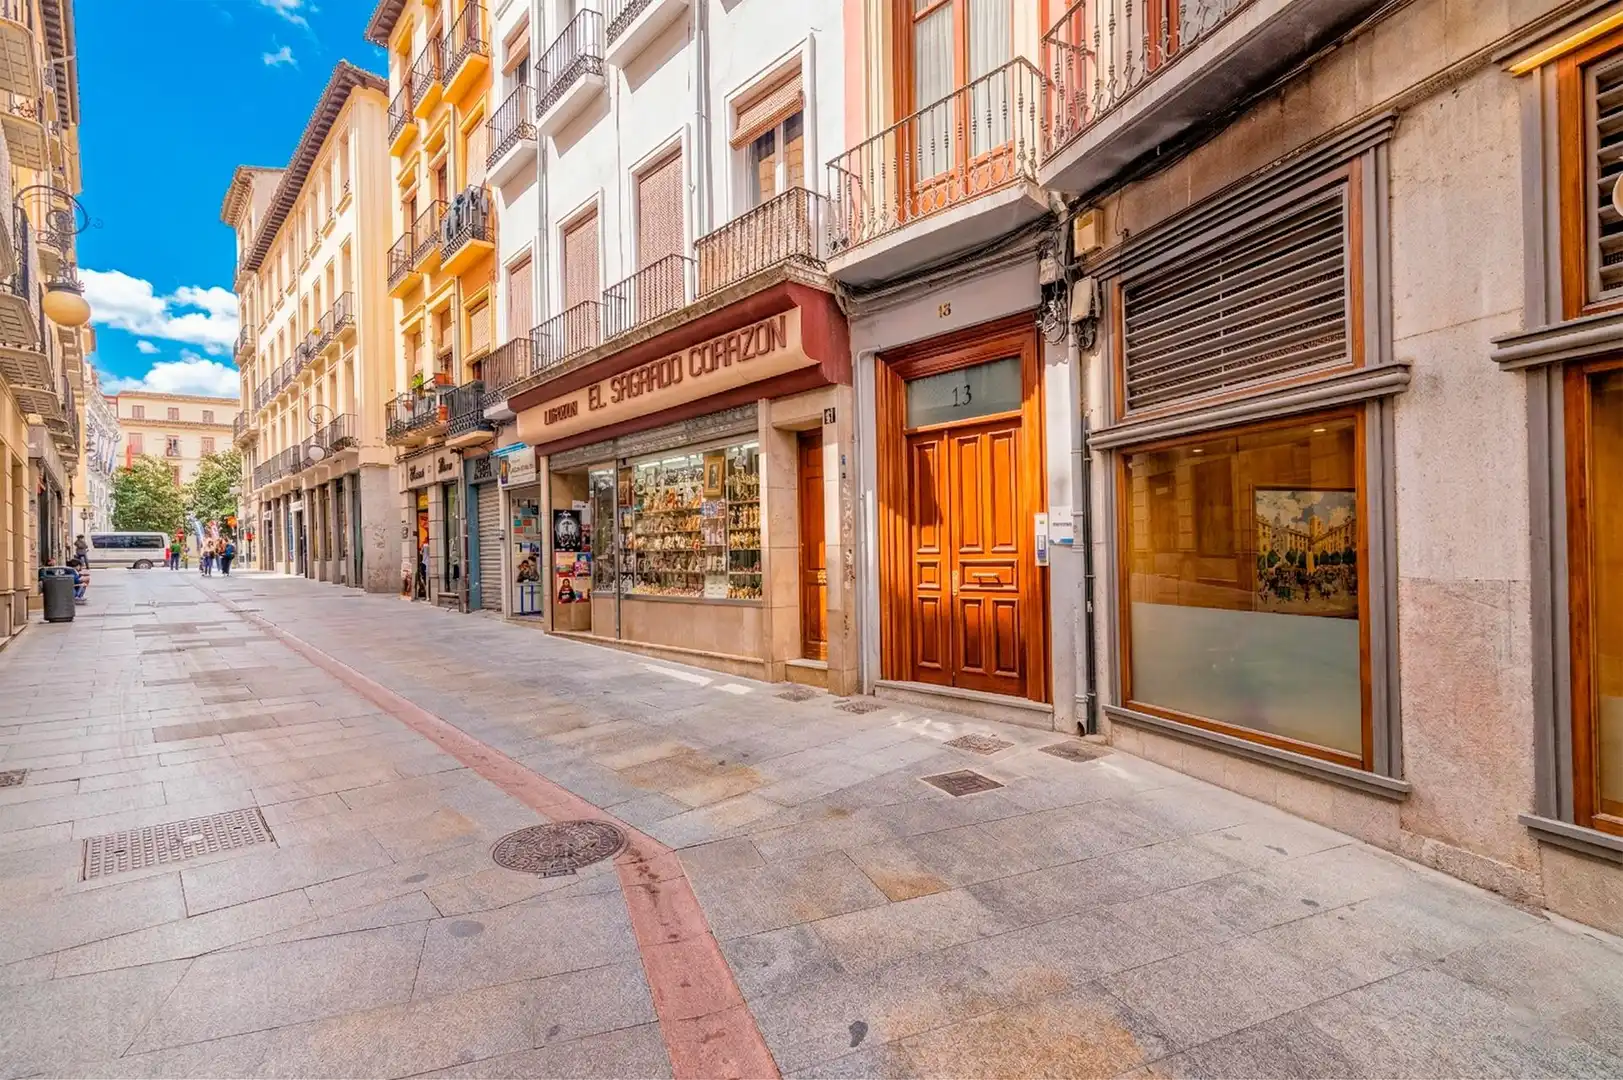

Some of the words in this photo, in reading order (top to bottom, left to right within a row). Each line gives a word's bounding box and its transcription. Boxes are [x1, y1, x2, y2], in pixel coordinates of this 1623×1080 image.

[937, 302, 952, 318] 13
[587, 384, 607, 412] EL
[609, 354, 684, 404] SAGRADO
[688, 315, 788, 378] CORAZON
[951, 384, 972, 407] 13
